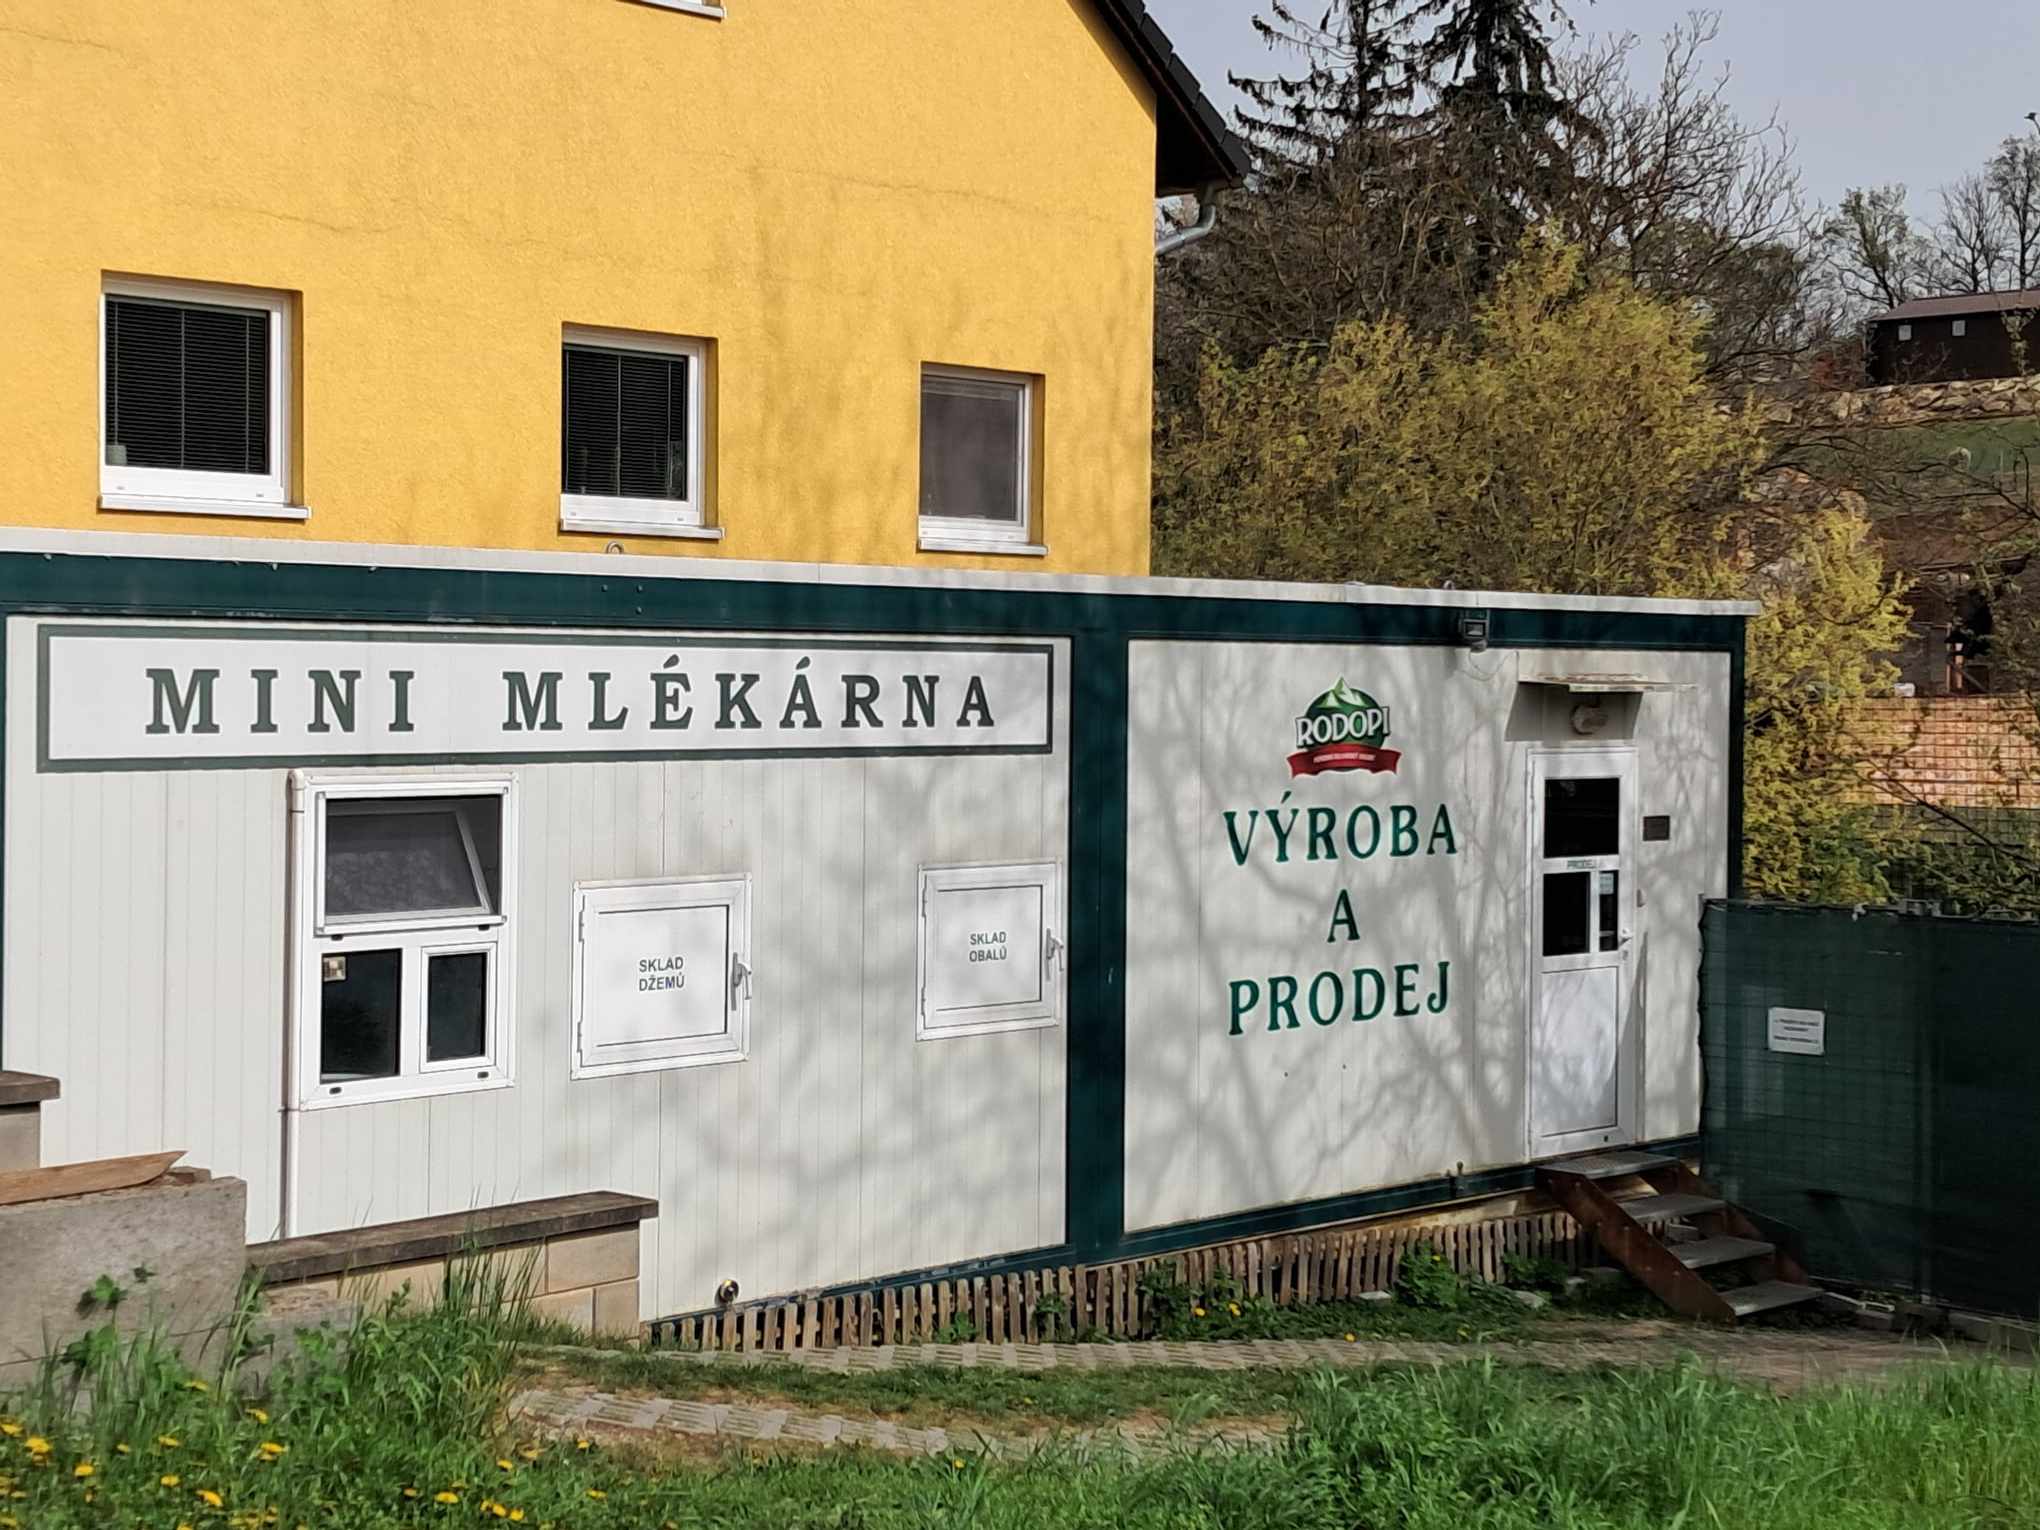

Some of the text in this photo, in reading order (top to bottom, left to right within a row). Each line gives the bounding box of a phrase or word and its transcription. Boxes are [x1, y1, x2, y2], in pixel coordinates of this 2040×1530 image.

[145, 654, 995, 735] MINI MLÉKÁRNA
[1296, 707, 1390, 748] RODOPI
[1223, 790, 1458, 866] VÝROBA
[1327, 889, 1360, 943] A
[969, 946, 1007, 963] OBALŮ
[970, 931, 1006, 946] SKLAD
[639, 956, 684, 972] SKLAD
[639, 972, 685, 992] DŽEMŮ
[1228, 961, 1450, 1036] PRODEJ
